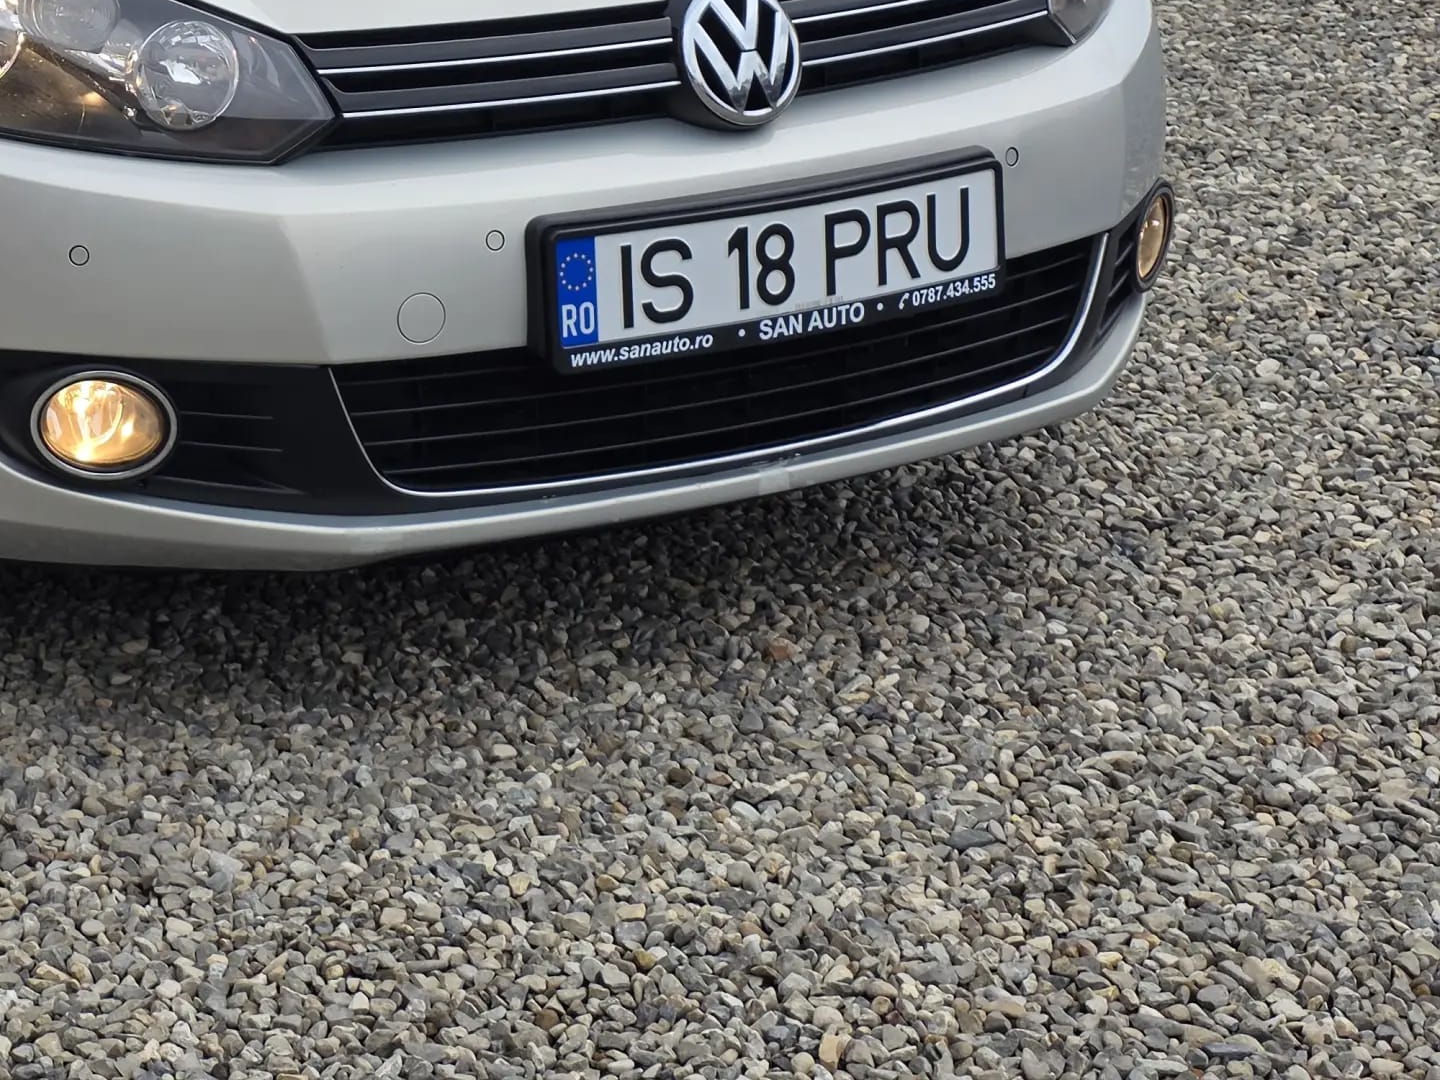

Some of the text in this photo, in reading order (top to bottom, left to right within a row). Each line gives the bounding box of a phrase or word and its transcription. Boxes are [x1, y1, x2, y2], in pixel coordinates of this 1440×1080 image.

[619, 185, 972, 330] IS 18 PRU
[561, 301, 596, 339] RO
[570, 273, 996, 368] www.sanauto.ro SAN AUTO 0787.434.555
